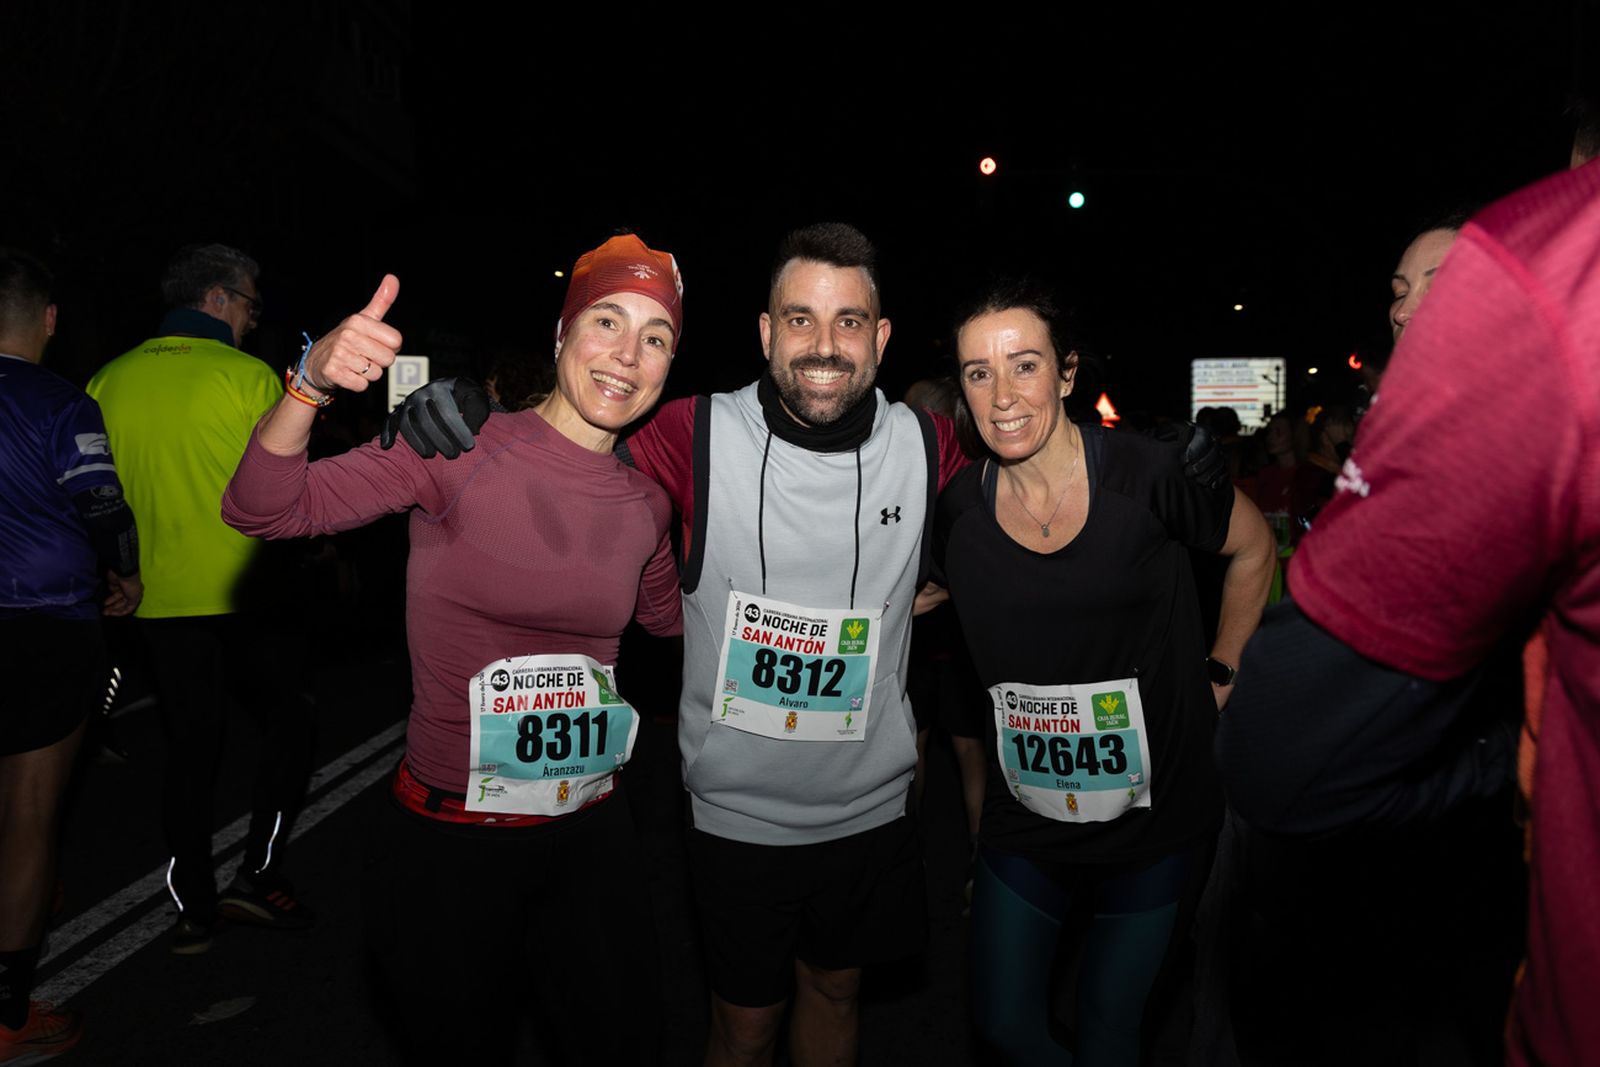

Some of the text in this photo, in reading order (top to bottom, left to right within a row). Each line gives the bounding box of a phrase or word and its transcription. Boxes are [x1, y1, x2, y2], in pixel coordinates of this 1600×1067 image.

[402, 363, 417, 383] P
[745, 607, 759, 619] 43
[761, 614, 828, 637] NOCHE DE
[742, 626, 826, 655] SAN ANTÓN
[491, 673, 509, 687] 43
[512, 667, 533, 675] CARRERA
[752, 648, 846, 697] 8312
[513, 672, 584, 690] NOCHE DE
[493, 694, 529, 713] SAN
[532, 688, 586, 710] ANTÓN
[779, 696, 809, 709] Alvaro
[1019, 700, 1078, 715] NOCHE DE
[1008, 714, 1081, 733] SAN ANTÓN
[515, 710, 608, 763] 8311
[1012, 733, 1127, 776] 12643
[542, 764, 585, 777] Áranzazu
[1056, 779, 1081, 790] Elena
